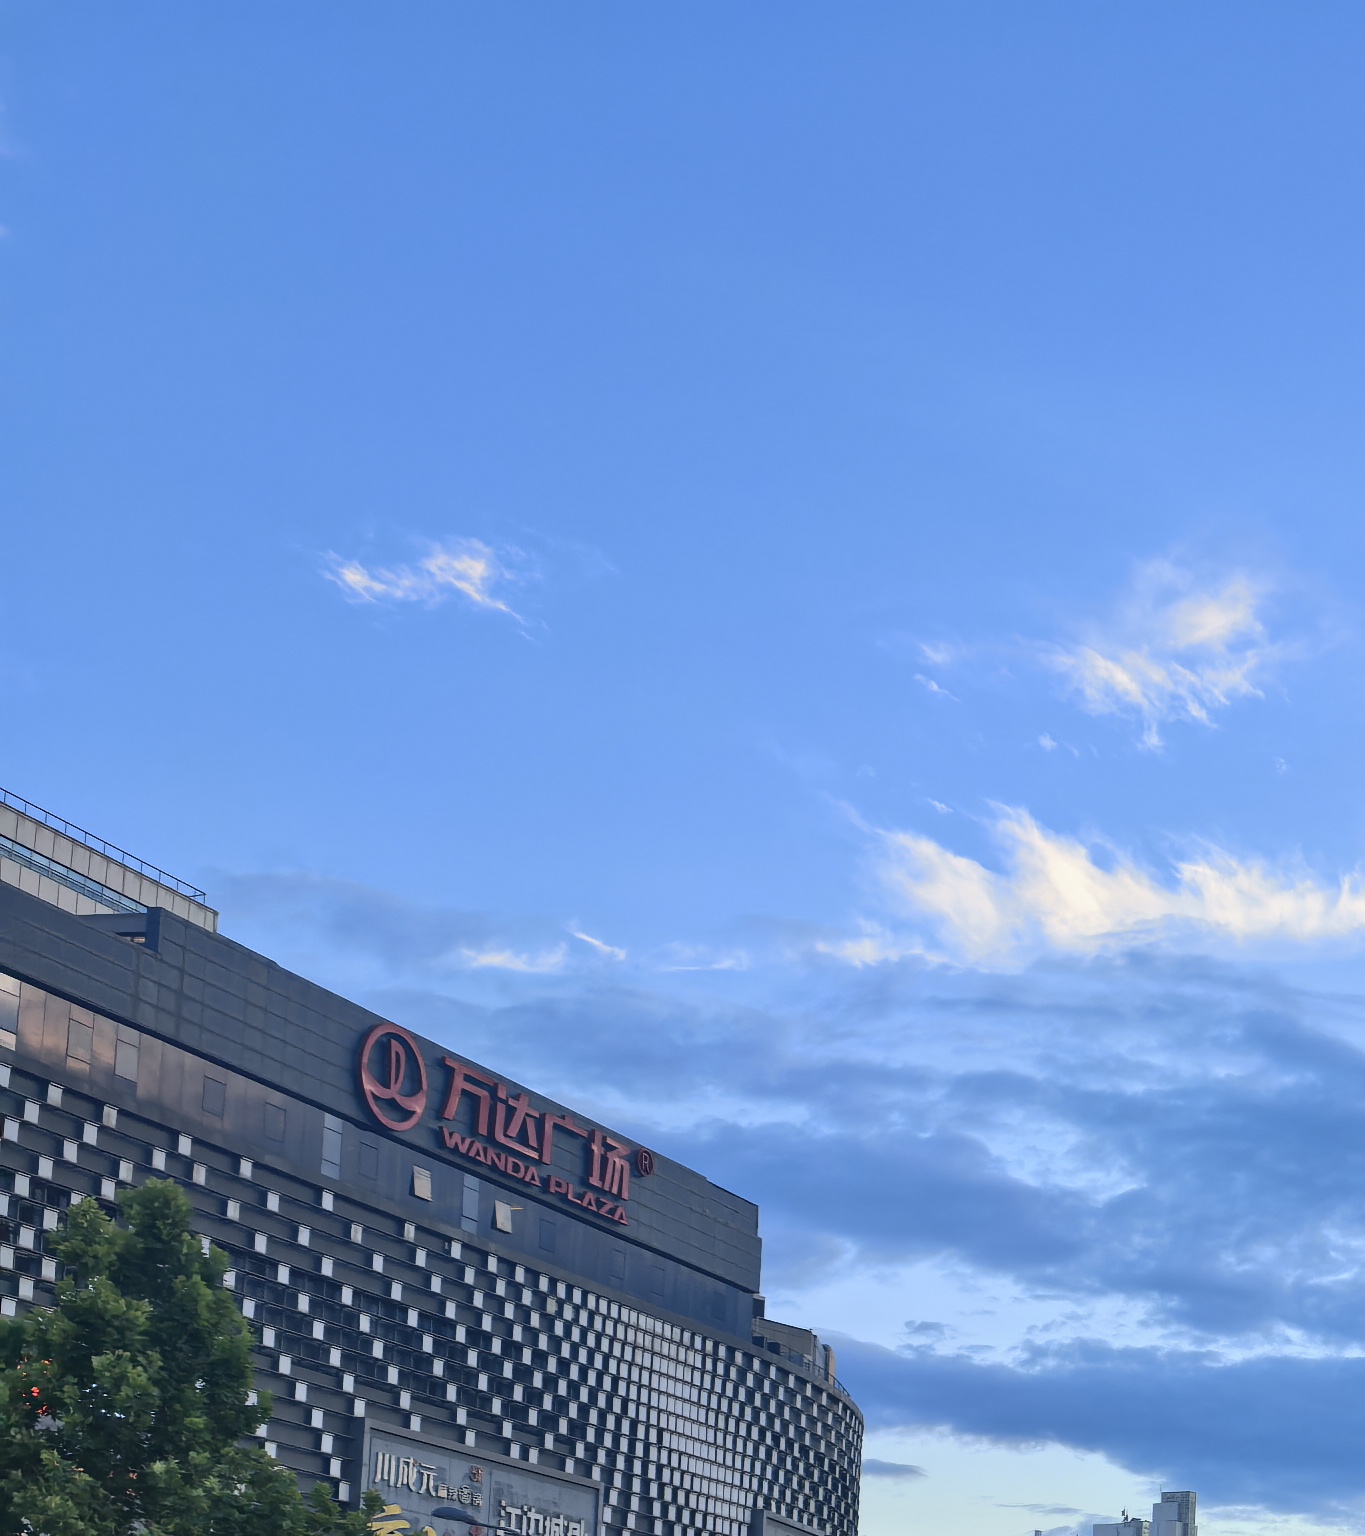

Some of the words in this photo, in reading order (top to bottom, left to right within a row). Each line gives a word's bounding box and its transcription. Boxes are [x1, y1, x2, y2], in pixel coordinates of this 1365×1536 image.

[439, 1126, 541, 1187] WANDA
[547, 1174, 629, 1226] PLAZA
[441, 1056, 633, 1200] 万达广场
[375, 1451, 438, 1497] 川成元
